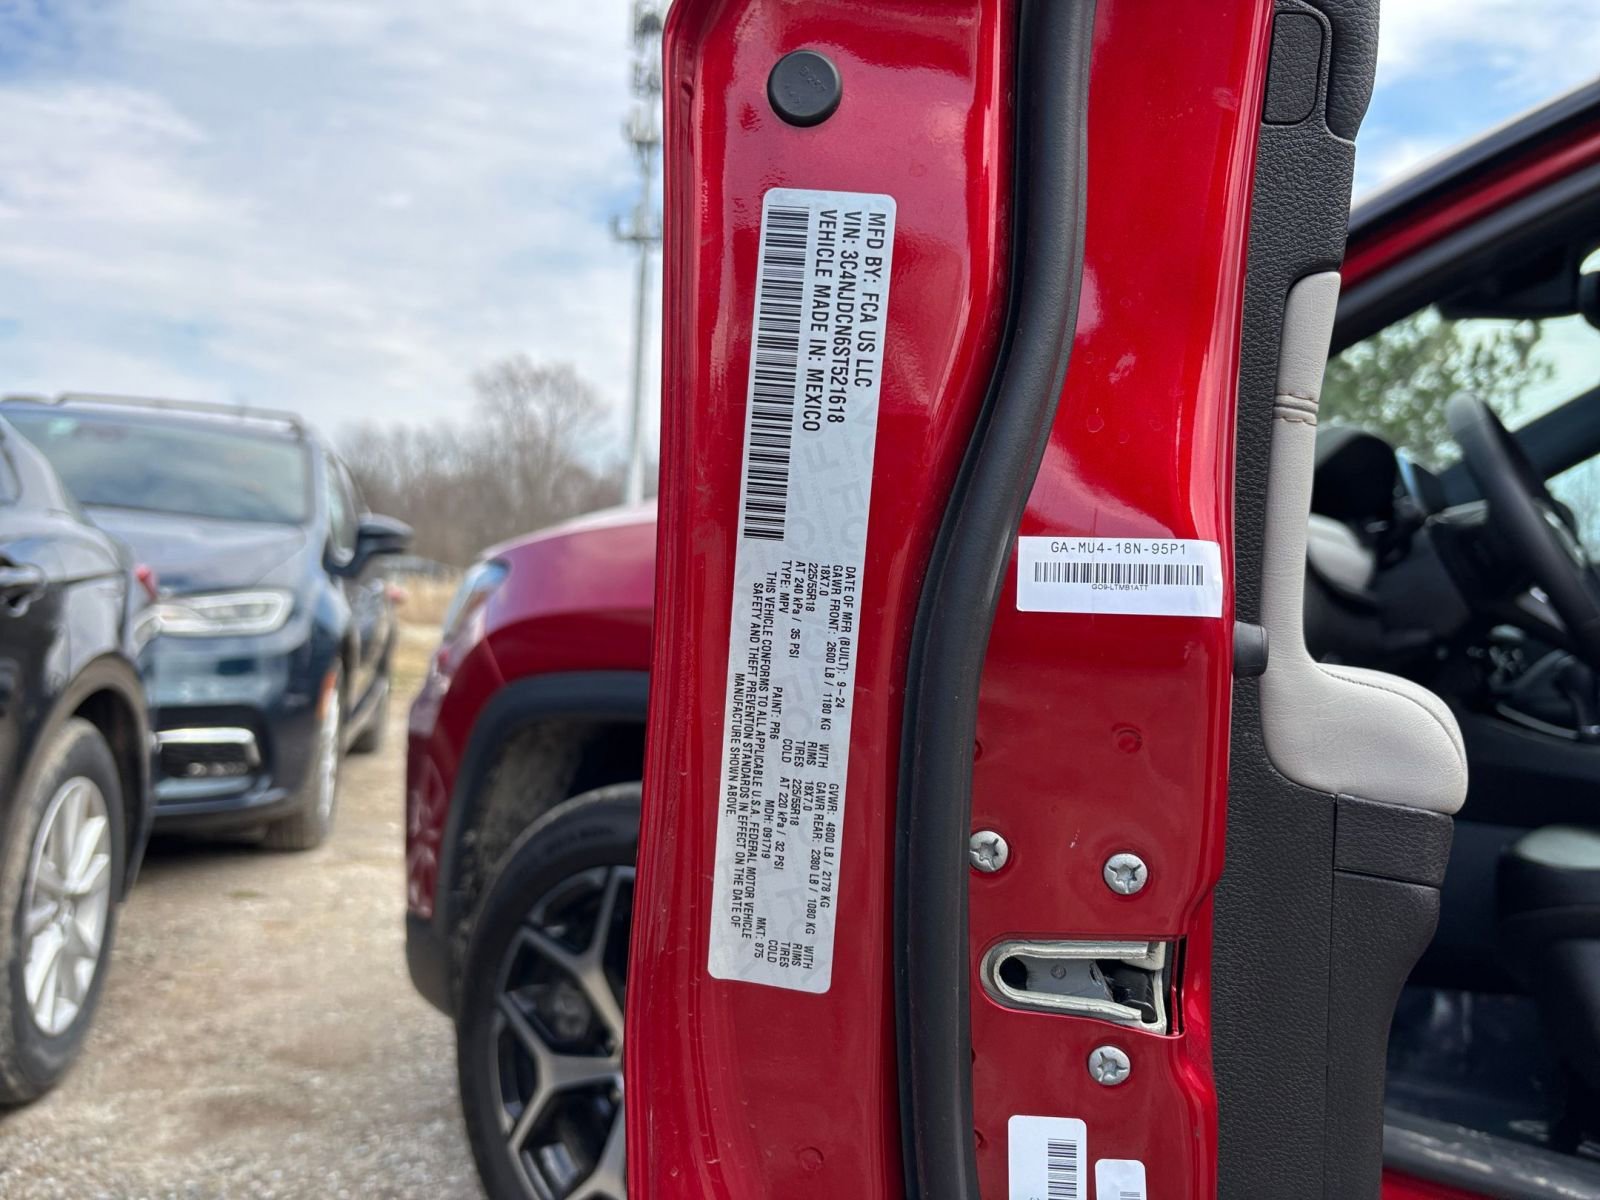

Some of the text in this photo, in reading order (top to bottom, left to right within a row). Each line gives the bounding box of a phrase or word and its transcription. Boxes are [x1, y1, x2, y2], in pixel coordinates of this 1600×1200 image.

[854, 212, 886, 388] MFD BY: FCA US LLC
[802, 209, 838, 432] VEHICLE MADE IN: MEXICO
[827, 211, 862, 423] VIN: 3C4NJDCN6ST521618
[1051, 541, 1185, 555] GA-MU4-18N-95P1
[795, 560, 806, 575] AT
[830, 564, 844, 595] GAWR
[844, 566, 857, 593] DATE
[778, 560, 793, 614] TYPE: MPV
[793, 577, 805, 595] 240
[805, 562, 819, 612] 225/55R18
[818, 564, 831, 597] 18X7.0
[792, 597, 804, 615] kPa
[843, 595, 854, 609] OF
[828, 598, 841, 634] FRONT:
[840, 611, 853, 633] MFR
[790, 628, 801, 640] 35
[789, 642, 800, 659] PSI
[825, 641, 837, 664] 2600
[836, 636, 851, 674] (BUILT):
[824, 666, 837, 679] LB
[769, 686, 783, 740] PAINT: PR6
[821, 693, 833, 715] 1180
[820, 717, 832, 731] KG
[725, 673, 745, 817] MANUFACTURE SHOWN ABOVE.
[731, 582, 764, 928] SAFETY AND THEFT PREVENTION STANDARDS IN EFFECT ON THE DATE OF
[741, 571, 778, 939] THIS VEHICLE CONFORMS TO ALL APPLICABLE U.S.A. FEDERAL MOTOR VEHICLE
[781, 738, 793, 763] COLD
[793, 740, 806, 768] TIRES
[806, 741, 818, 766] RIMS
[817, 744, 830, 769] WITH
[779, 776, 790, 790] AT
[778, 792, 789, 809] 220
[789, 778, 803, 826] 225/55R18
[802, 781, 815, 812] 18X7.0
[814, 781, 827, 811] GAWR
[827, 783, 839, 815] GVWR:
[761, 799, 775, 859] MDH: 091719
[776, 811, 788, 828] kPa
[812, 813, 825, 842] REAR:
[825, 821, 836, 844] 4800
[774, 840, 785, 853] 32
[823, 846, 835, 858] LB
[773, 854, 785, 870] PSI
[810, 849, 821, 871] 2380
[809, 873, 820, 885] LB
[821, 870, 832, 893] 2178
[806, 899, 817, 920] 1080
[819, 895, 831, 908] KG
[754, 917, 767, 959] MKT: 875
[805, 922, 816, 935] KG
[767, 939, 779, 963] COLD
[779, 942, 791, 968] TIRES
[791, 943, 803, 967] RIMS
[802, 946, 814, 970] WITH
